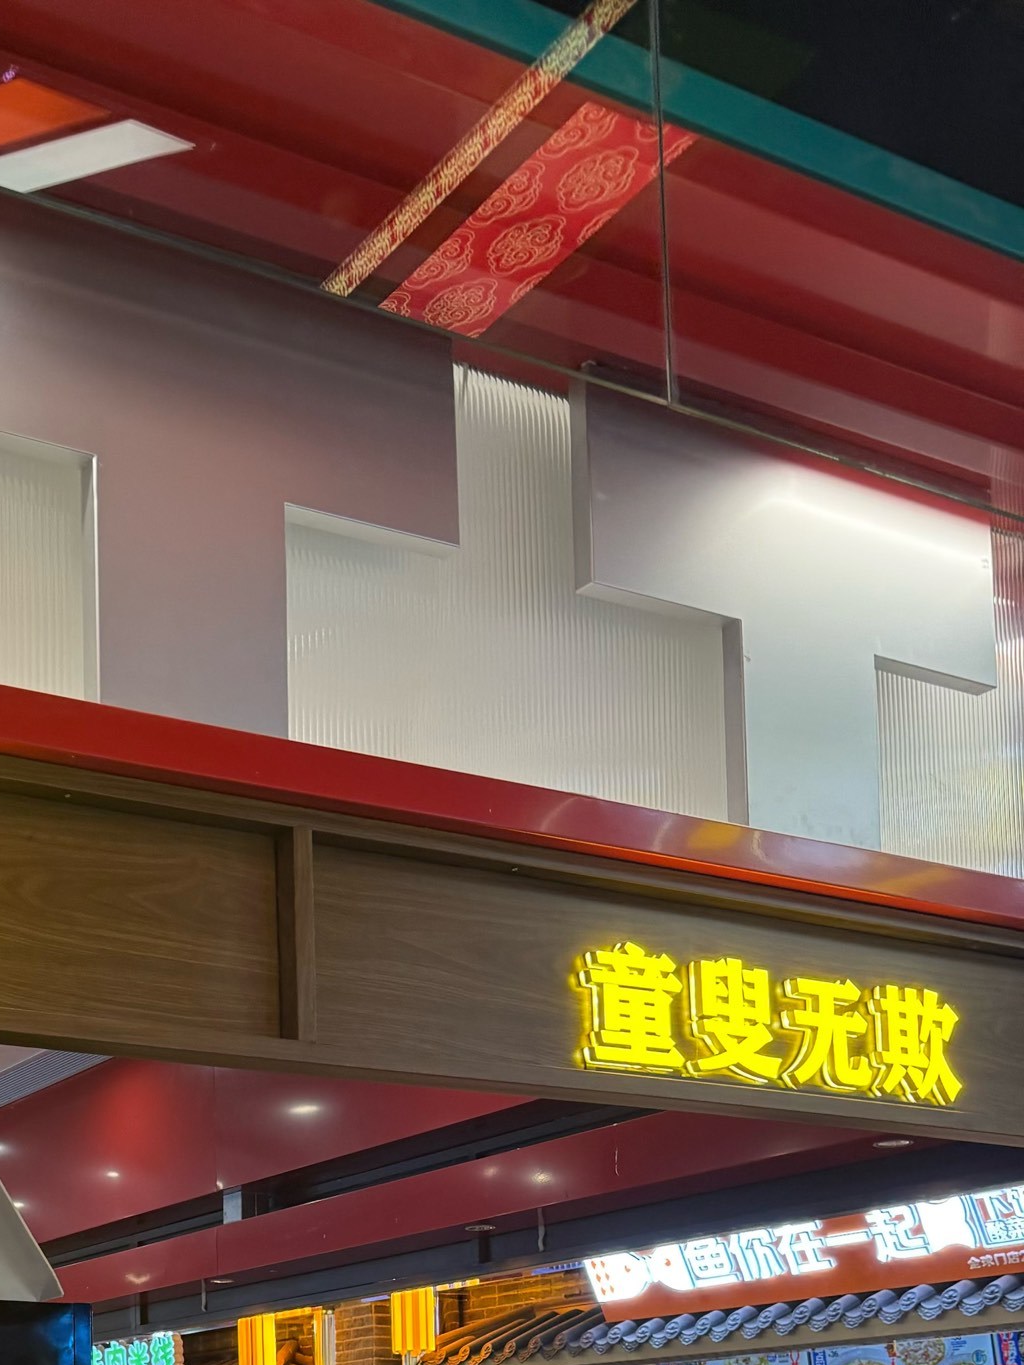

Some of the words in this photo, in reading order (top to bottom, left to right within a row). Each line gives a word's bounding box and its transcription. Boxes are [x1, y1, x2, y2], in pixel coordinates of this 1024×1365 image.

[578, 941, 964, 1106] 童叟无欺
[684, 1203, 931, 1288] 鱼你在一起
[967, 1249, 1024, 1270] 全球门店
